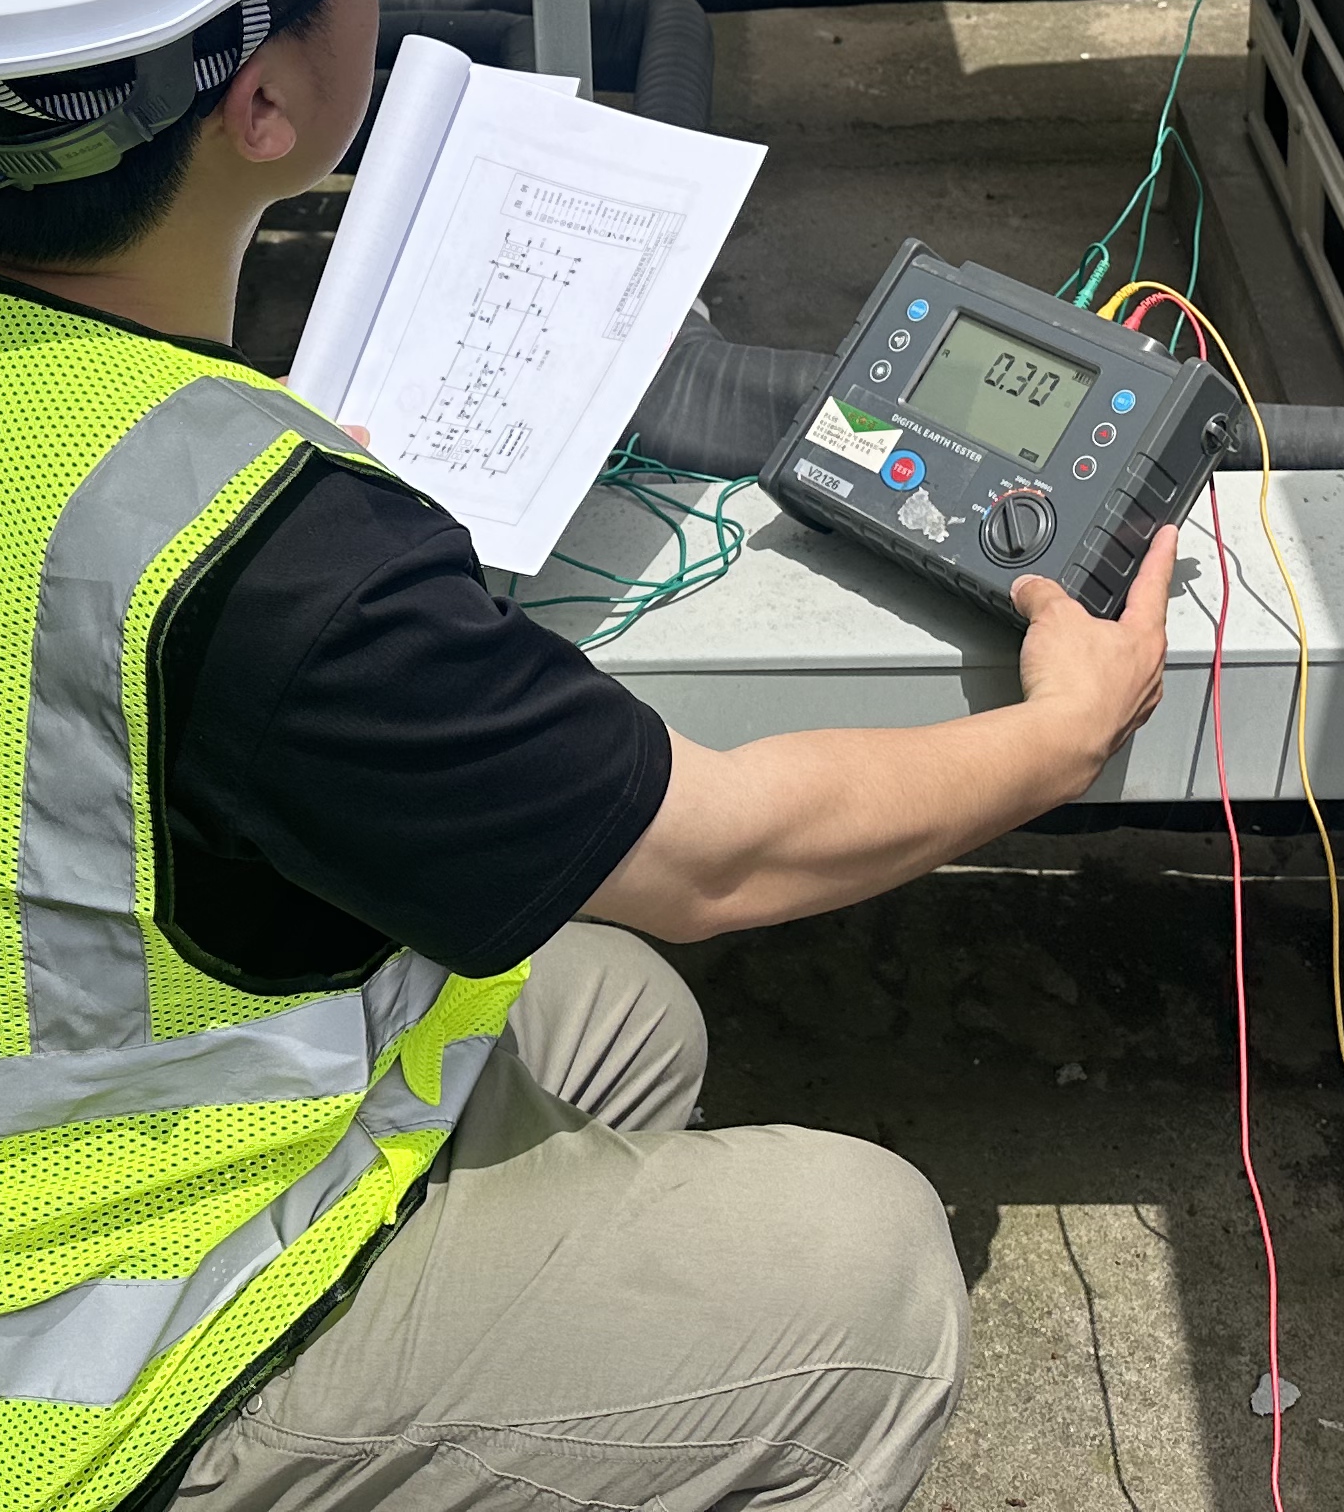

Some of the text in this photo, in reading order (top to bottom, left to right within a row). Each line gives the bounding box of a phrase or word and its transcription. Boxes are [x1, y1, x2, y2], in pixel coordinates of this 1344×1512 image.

[984, 352, 1060, 407] 0.30
[891, 413, 923, 435] DIGITAL
[923, 429, 951, 448] EARTH
[951, 441, 983, 463] TESTER
[808, 466, 841, 490] V2126
[893, 463, 913, 478] TEST
